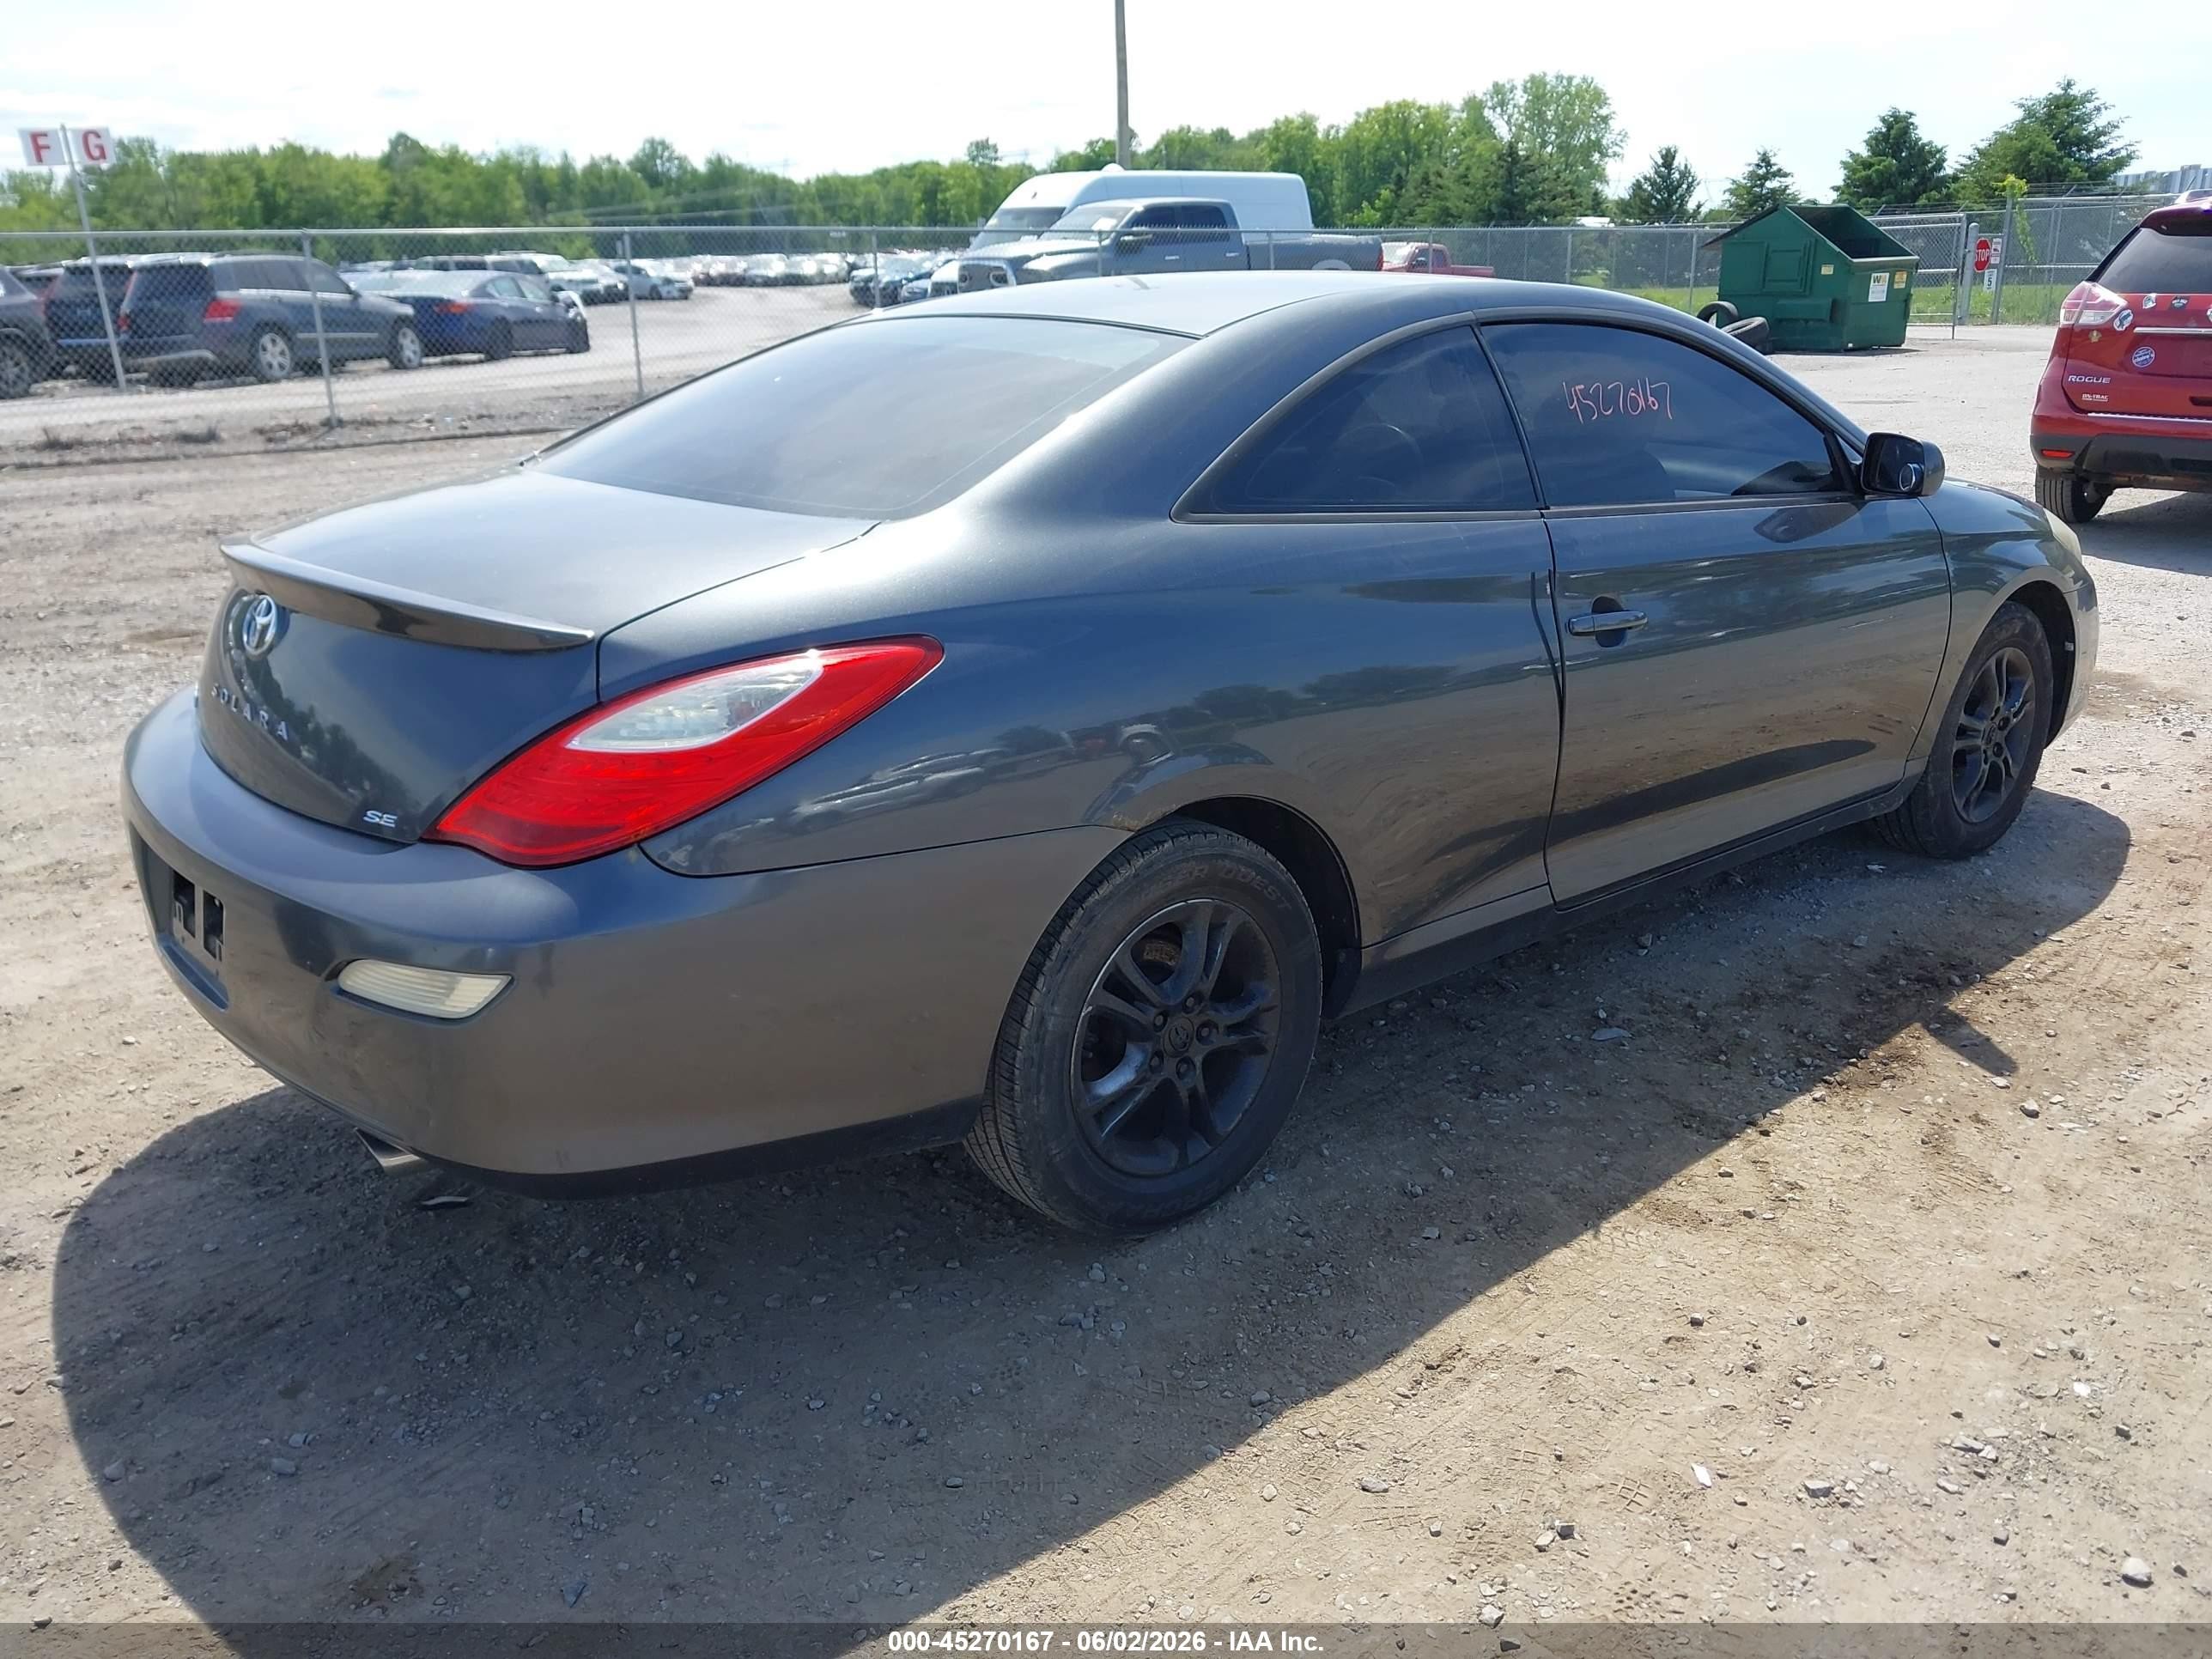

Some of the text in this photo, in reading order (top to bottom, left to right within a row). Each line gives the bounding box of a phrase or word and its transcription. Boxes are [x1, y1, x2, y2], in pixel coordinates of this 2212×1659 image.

[29, 131, 51, 163] F
[82, 130, 106, 161] G
[1975, 248, 1990, 262] STOP
[1987, 276, 1993, 287] 5
[1563, 378, 1673, 424] 45270167
[211, 683, 289, 740] SOLARA
[362, 810, 398, 828] SE
